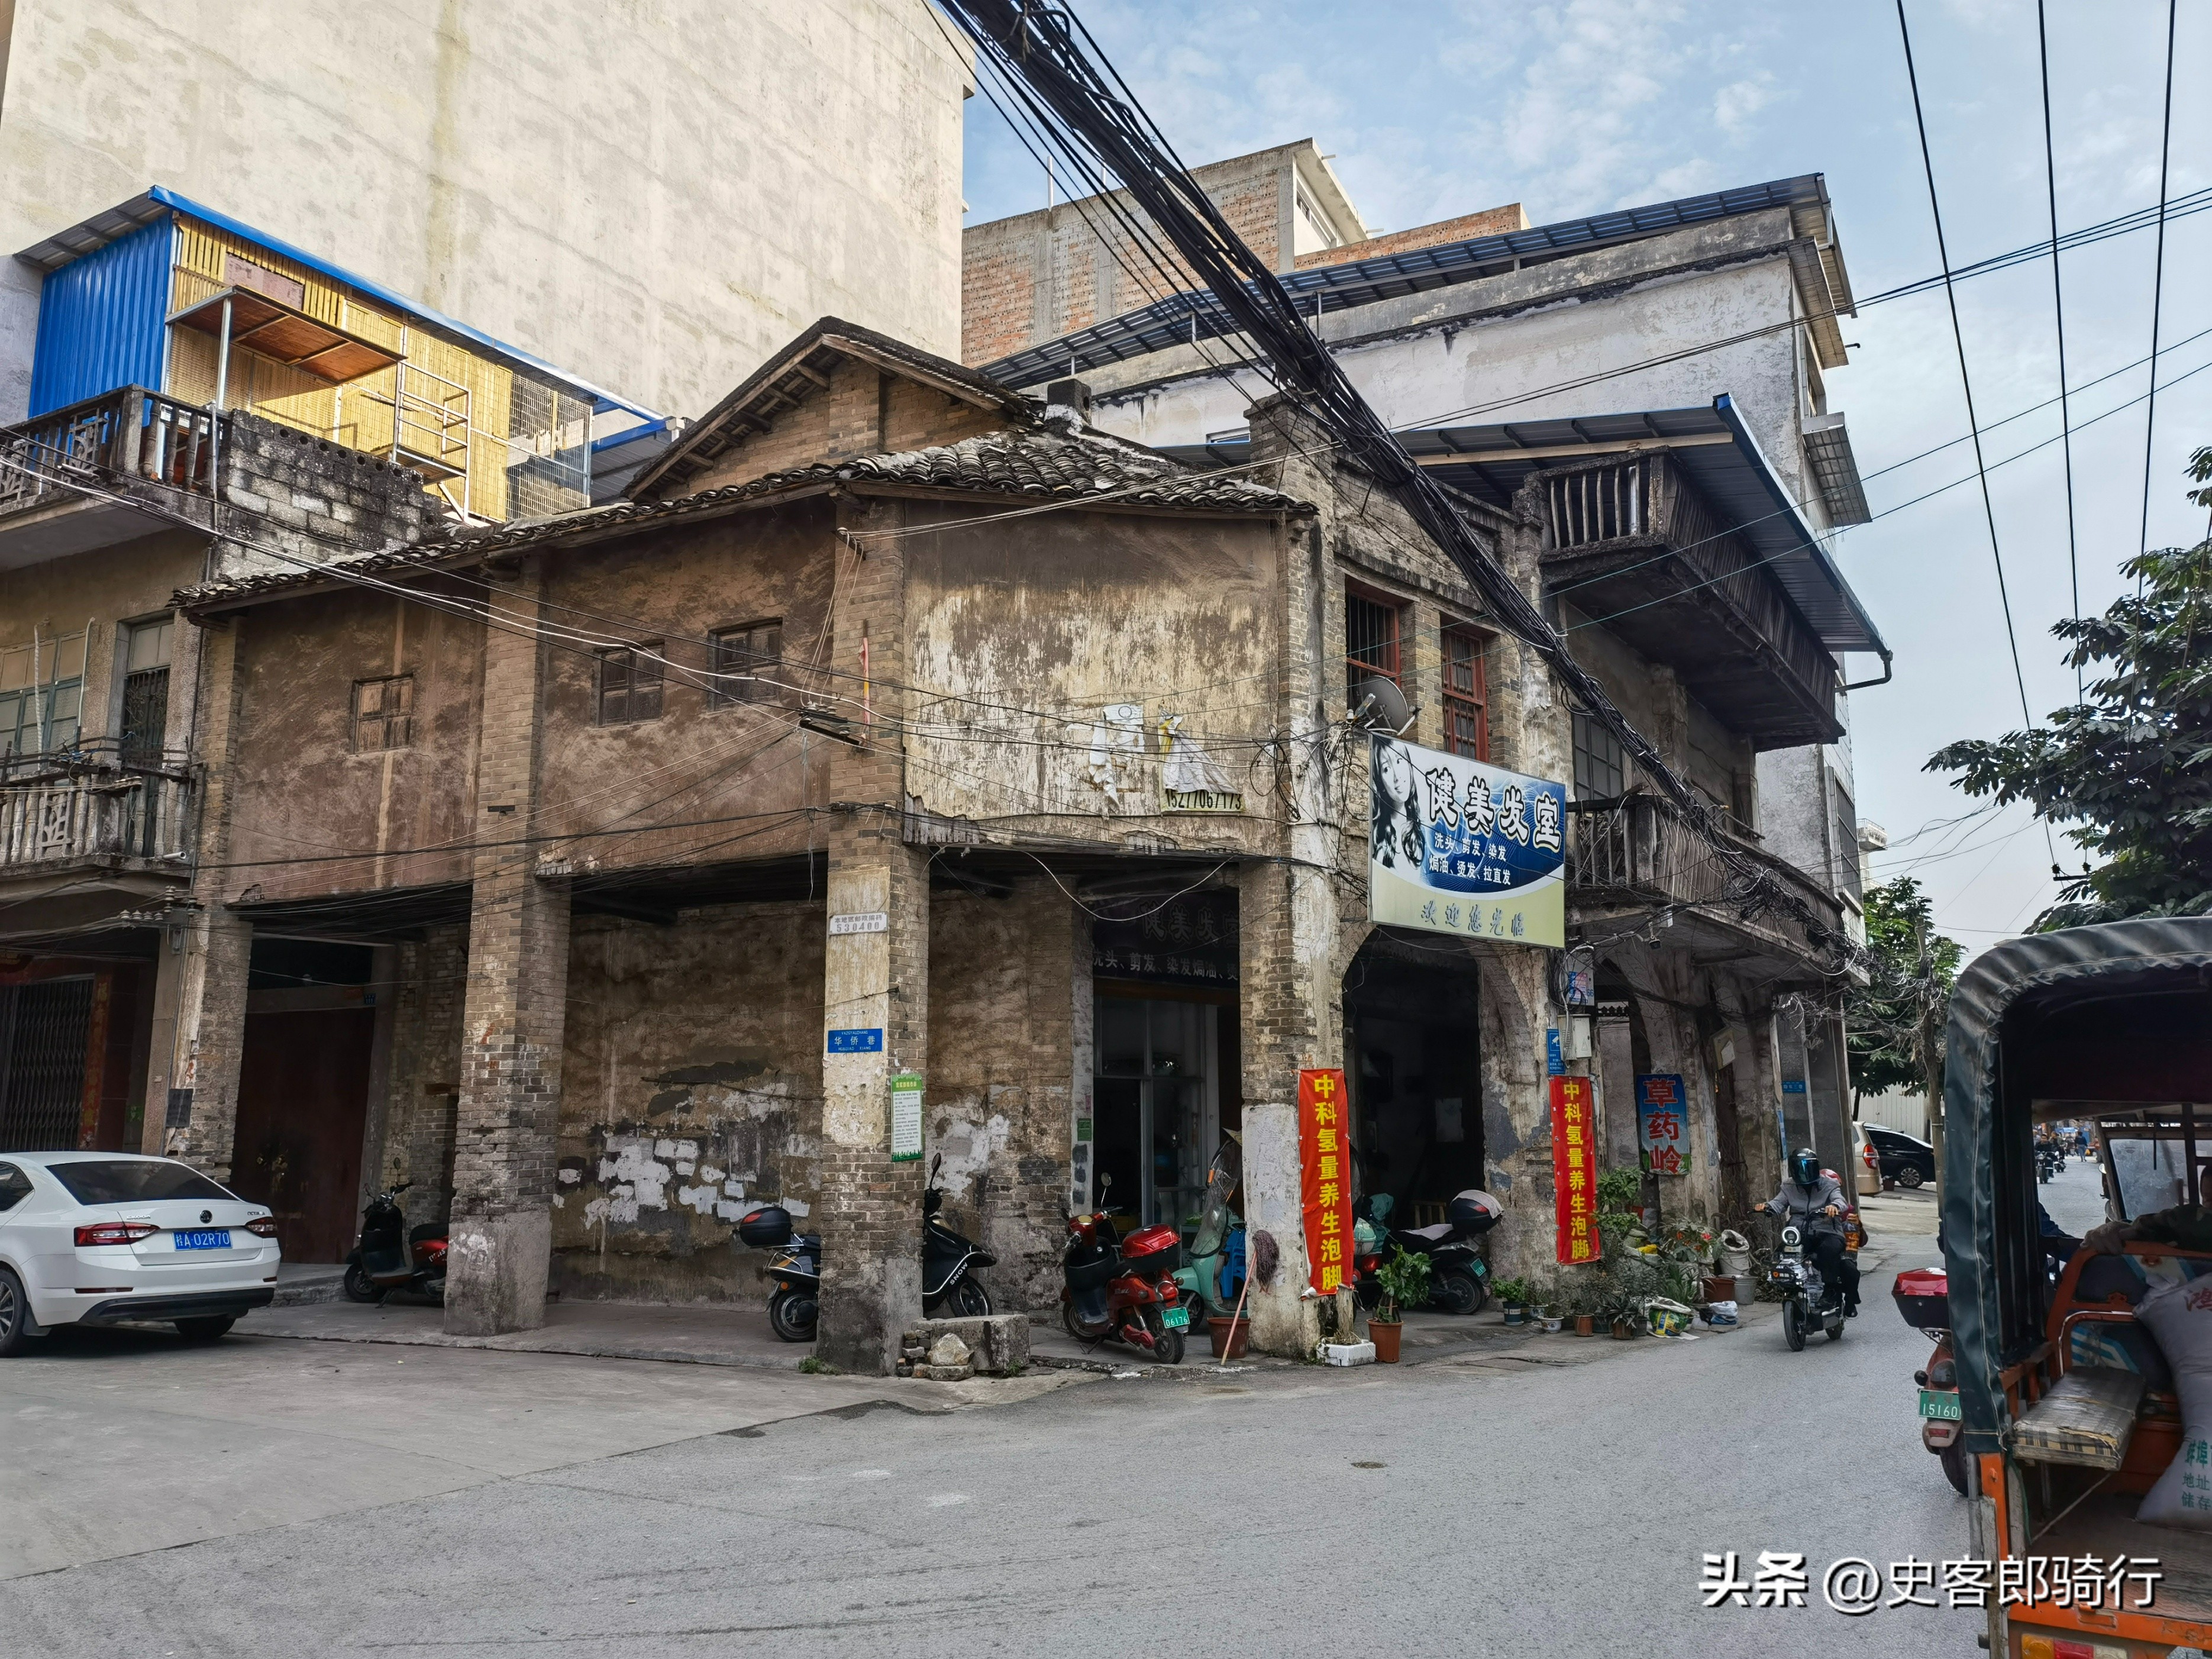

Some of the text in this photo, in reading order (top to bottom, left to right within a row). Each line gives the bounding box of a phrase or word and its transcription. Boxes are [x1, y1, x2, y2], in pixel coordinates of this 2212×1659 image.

[1426, 767, 1561, 852] 健美发室
[1435, 832, 1507, 861] 洗头、剪发、染发
[1429, 855, 1511, 885] 焗油、烫发、拉直发
[835, 915, 883, 923] 本地区邮政编码
[837, 922, 879, 932] 530400
[1420, 900, 1525, 937] 欢迎您光临
[834, 1035, 875, 1045] 华侨巷
[1643, 1078, 1683, 1174] 草药岭
[1314, 1074, 1342, 1291] 中科氢量养生泡脚
[1564, 1080, 1589, 1260] 中科氢量养生泡脚
[950, 1262, 968, 1285] SNOW
[1165, 1316, 1188, 1326] 06176
[1923, 1403, 1958, 1418] 15160
